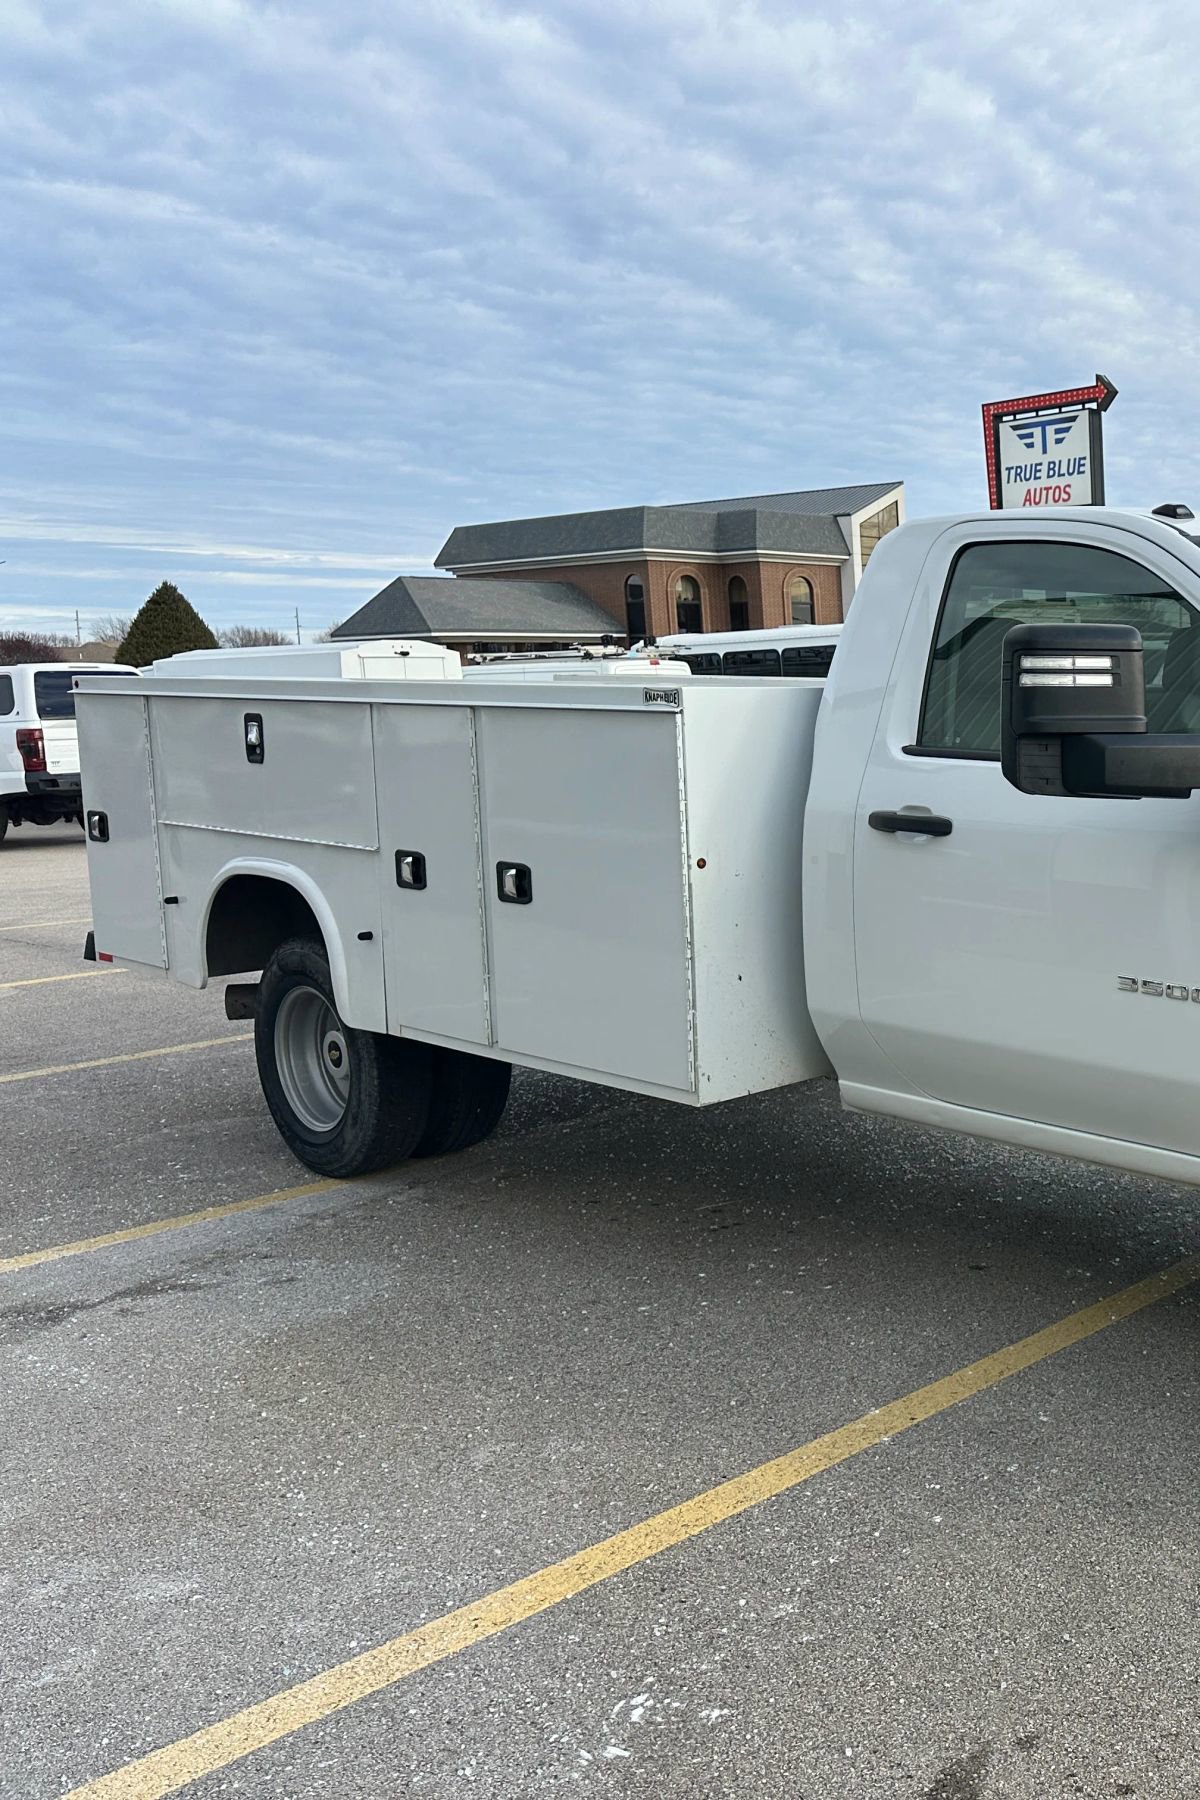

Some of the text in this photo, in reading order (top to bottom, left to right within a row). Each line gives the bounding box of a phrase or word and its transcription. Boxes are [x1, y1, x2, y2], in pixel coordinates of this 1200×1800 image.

[1005, 456, 1087, 485] TRUE BLUE
[1022, 484, 1072, 507] AUTOS
[644, 690, 678, 705] KNAPHEIDE
